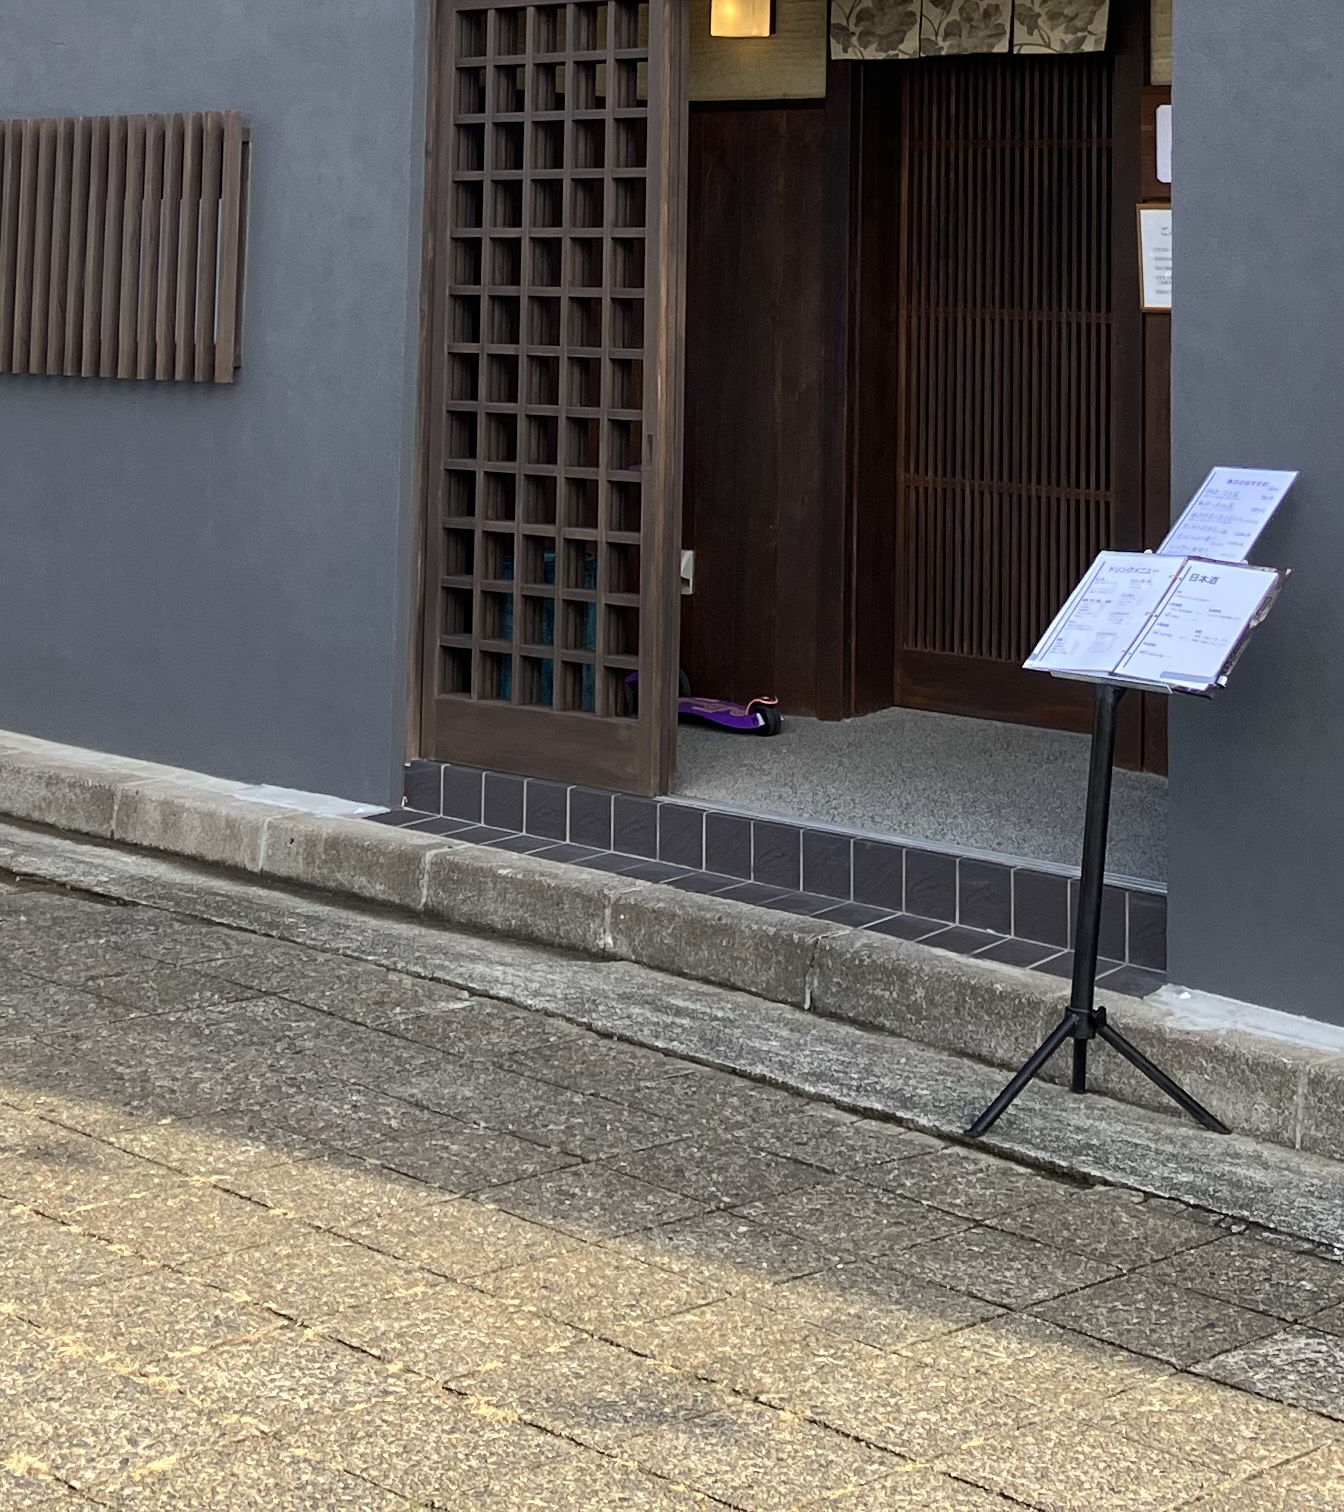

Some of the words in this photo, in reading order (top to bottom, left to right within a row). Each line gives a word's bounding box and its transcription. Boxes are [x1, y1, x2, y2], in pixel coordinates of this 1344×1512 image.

[1108, 566, 1159, 575] ドリンクメニュー
[1188, 572, 1220, 586] 日本酒
